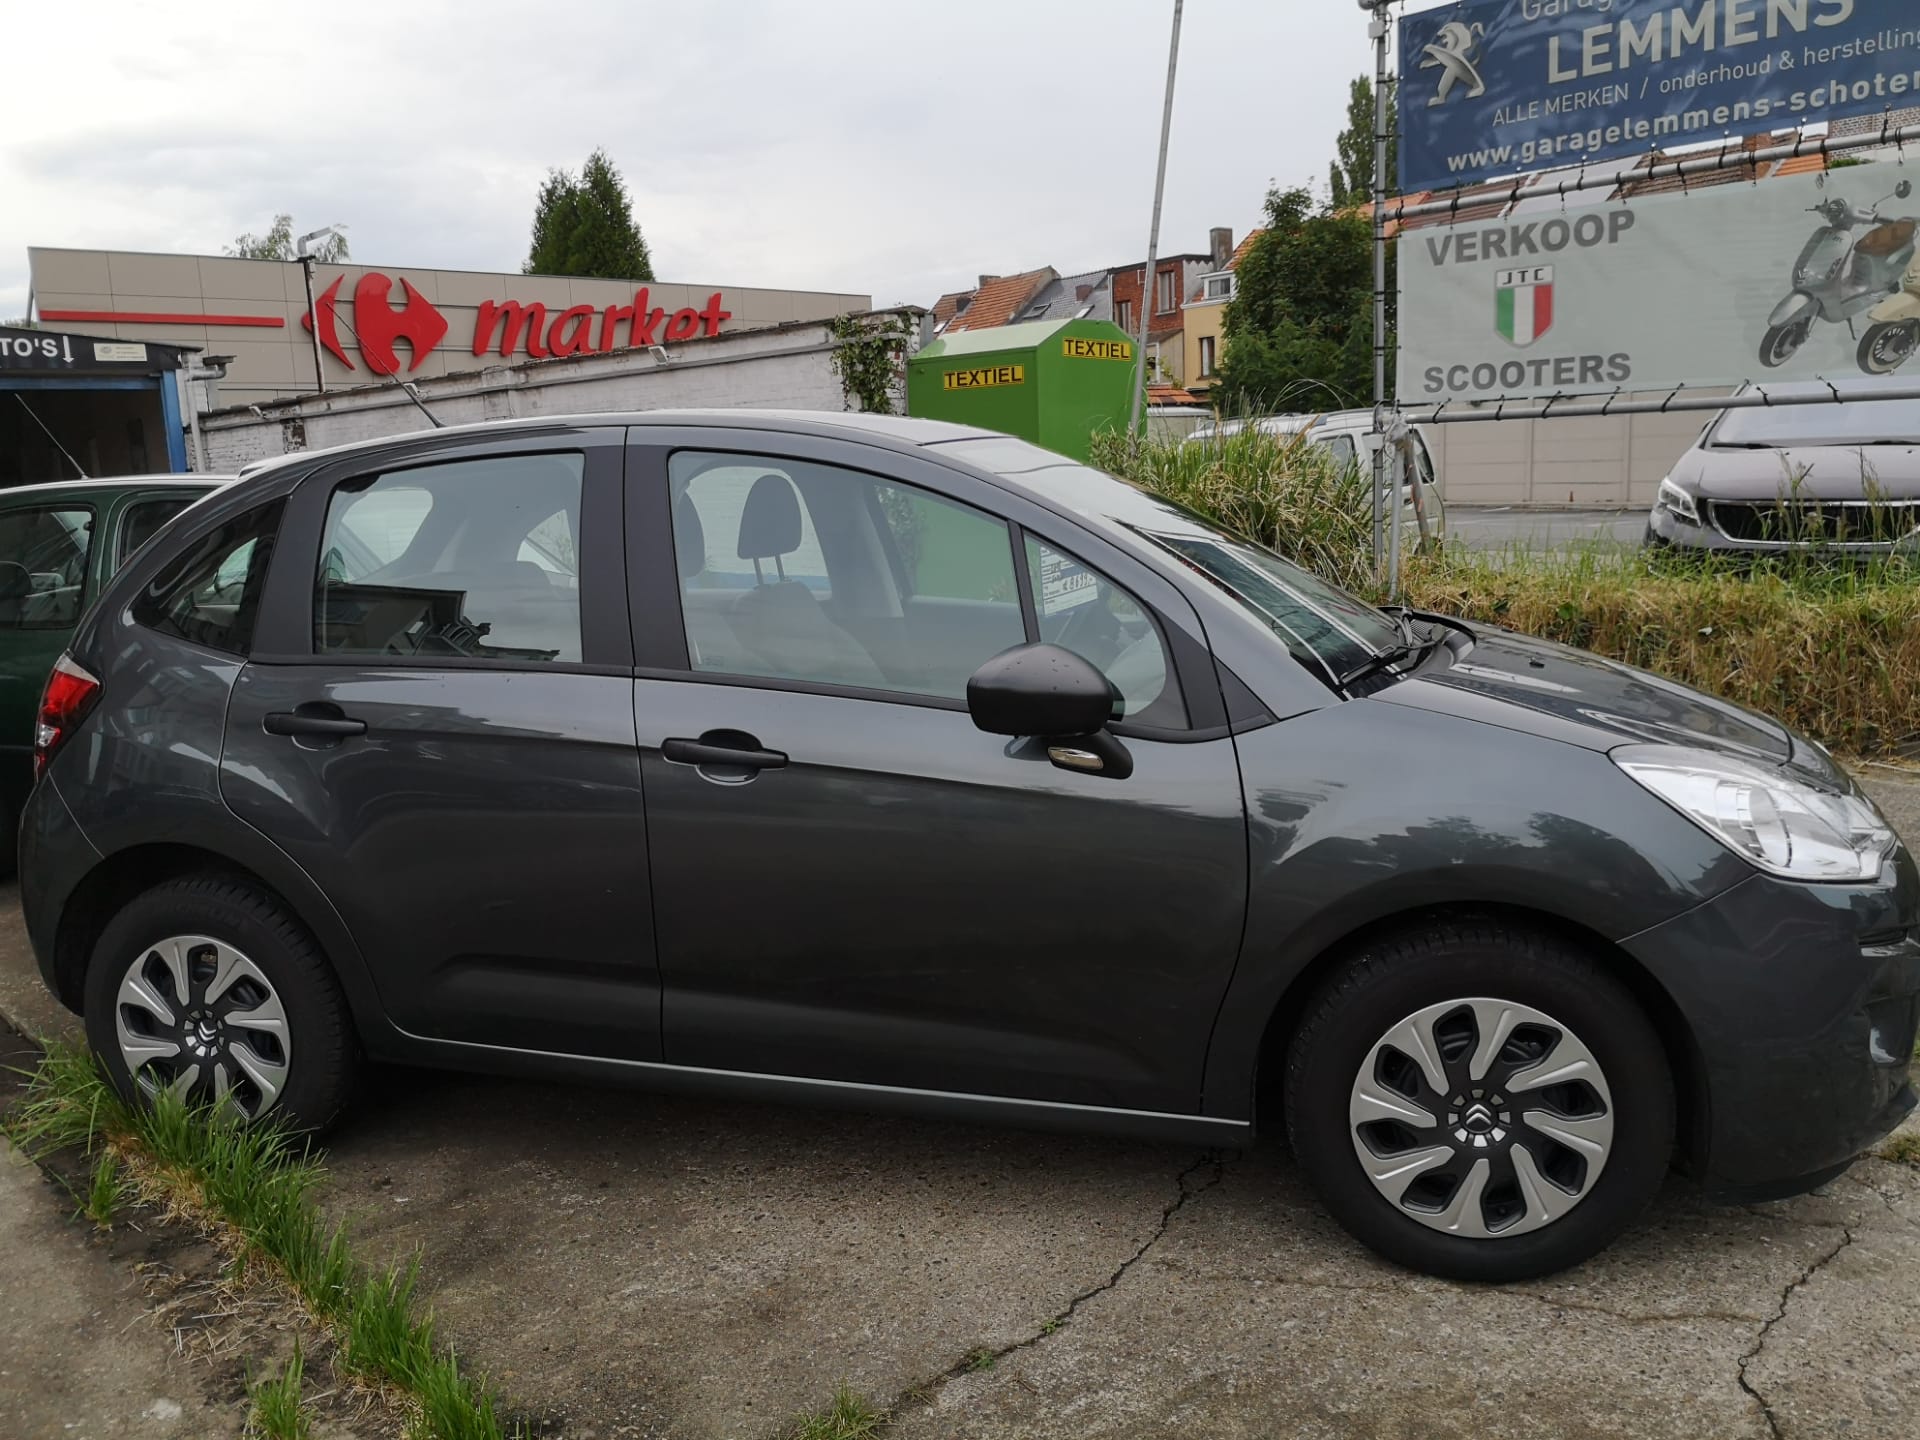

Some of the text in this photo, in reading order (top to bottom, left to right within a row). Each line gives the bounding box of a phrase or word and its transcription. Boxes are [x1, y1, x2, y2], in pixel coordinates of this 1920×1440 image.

[1548, 0, 1854, 84] LEMMENS
[1492, 100, 1539, 127] ALLE
[1544, 83, 1629, 116] MERKEN
[1659, 54, 1771, 94] onderhoud
[1778, 50, 1795, 71] &
[1804, 28, 1920, 66] herstellin
[1425, 209, 1635, 267] VERKOOP
[472, 287, 732, 358] market
[1064, 339, 1130, 359] TEXTIEL
[944, 367, 1022, 388] TEXTIEL
[1423, 352, 1632, 393] SCOOTERS
